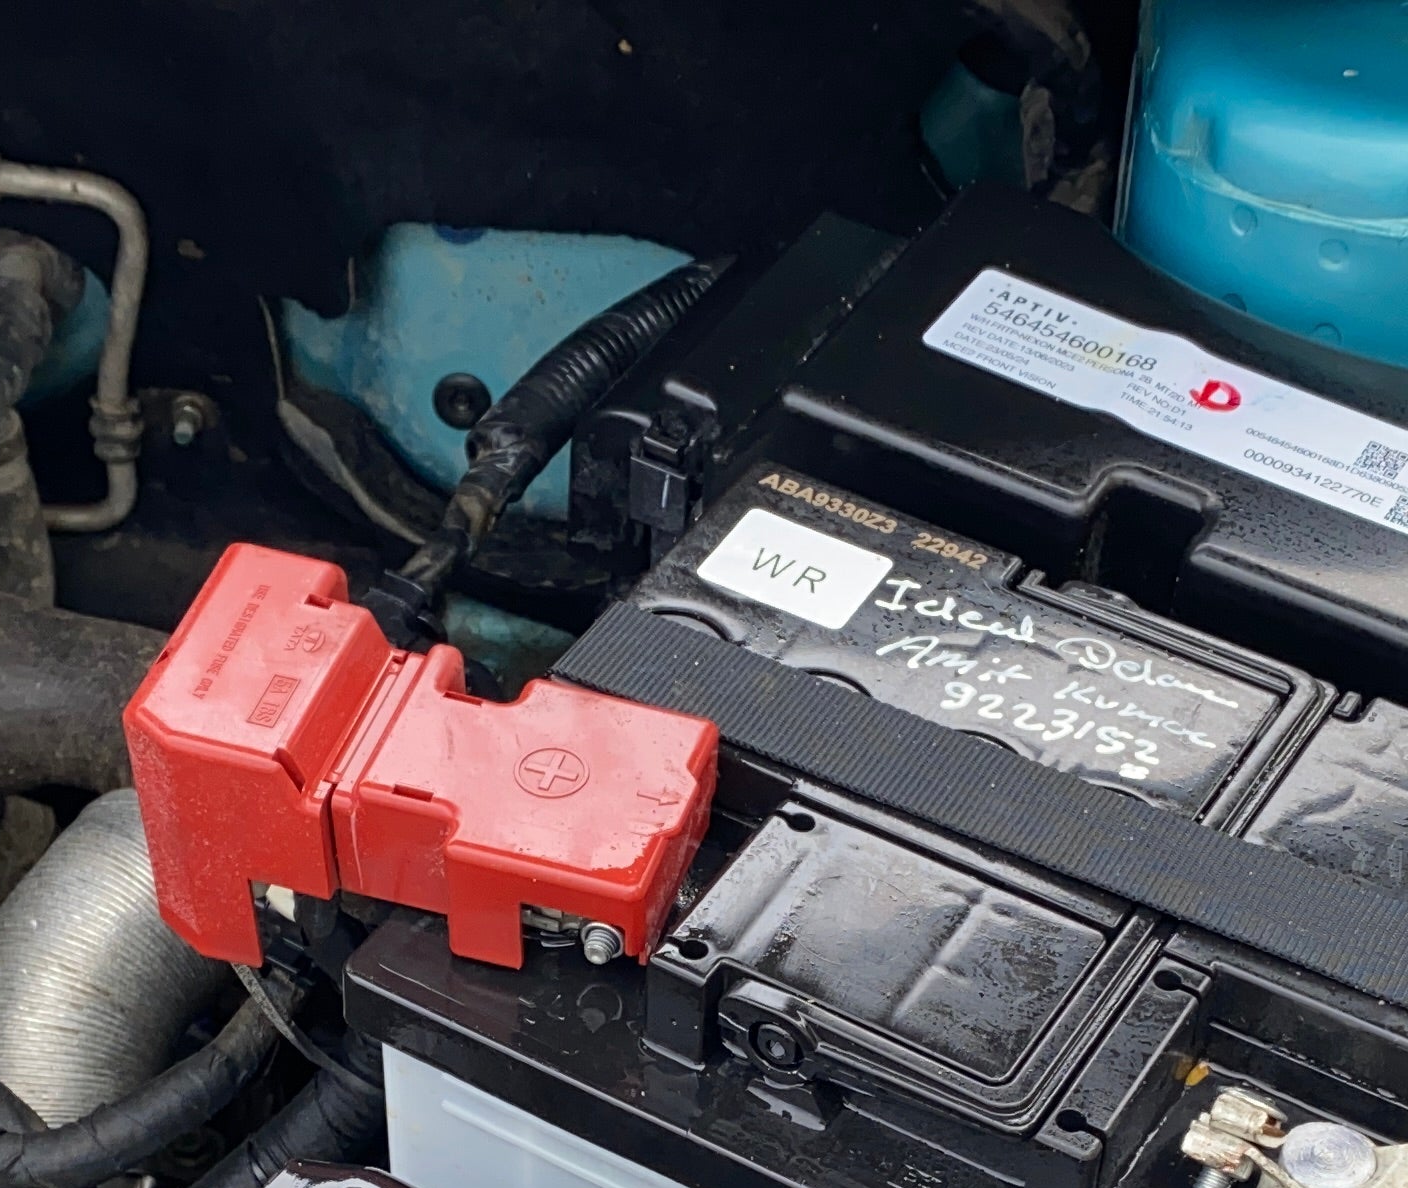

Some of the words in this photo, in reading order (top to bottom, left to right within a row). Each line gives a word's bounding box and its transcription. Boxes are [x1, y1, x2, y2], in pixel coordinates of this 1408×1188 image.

[996, 290, 1071, 324] APTIV
[983, 301, 1157, 371] 546454600168
[975, 351, 1016, 374] FRONT
[1017, 367, 1057, 390] VISION
[1243, 448, 1385, 508] 0000934122770E
[910, 531, 989, 570] 22942
